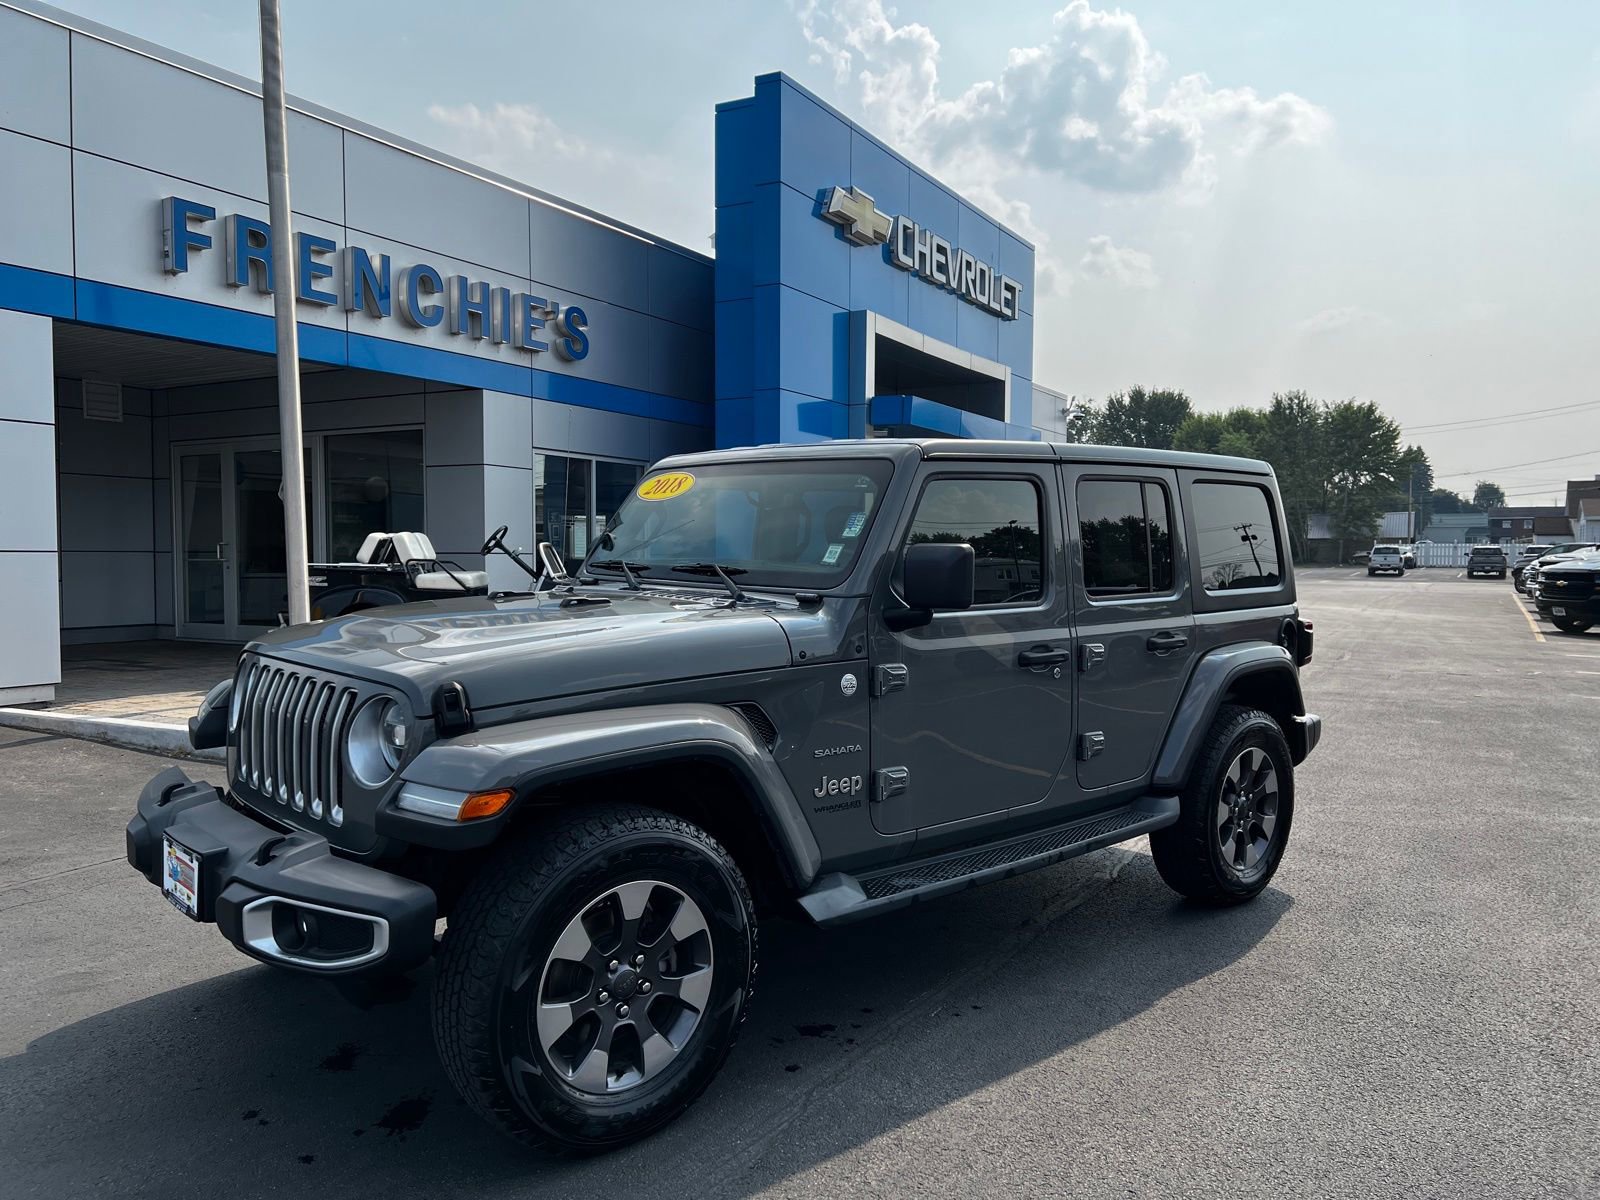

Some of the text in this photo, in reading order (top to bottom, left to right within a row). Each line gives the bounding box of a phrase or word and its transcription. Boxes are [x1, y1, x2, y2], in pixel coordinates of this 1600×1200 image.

[891, 214, 1023, 320] CHEVROLET
[162, 196, 589, 362] FRENCHIE'S
[643, 476, 688, 495] 2018
[814, 744, 862, 758] SAHARA
[814, 775, 863, 798] Jeep
